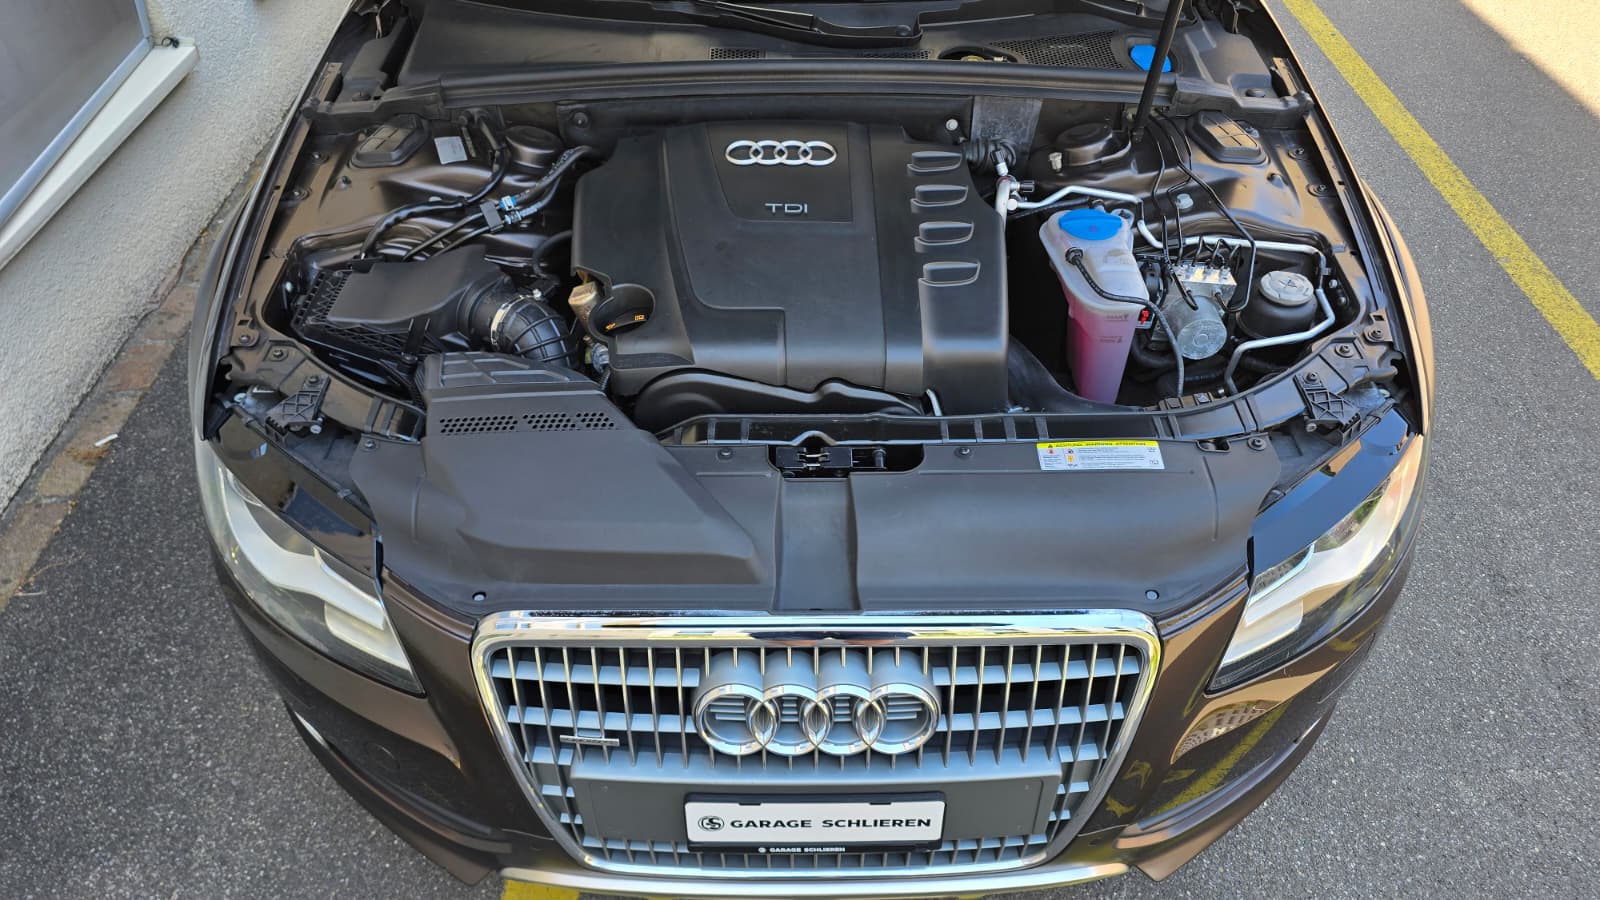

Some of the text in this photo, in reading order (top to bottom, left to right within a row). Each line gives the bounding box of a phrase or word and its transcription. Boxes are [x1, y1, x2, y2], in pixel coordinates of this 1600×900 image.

[765, 203, 808, 213] TDI
[730, 820, 812, 828] GARAGE
[822, 819, 931, 828] SCHLIEREN
